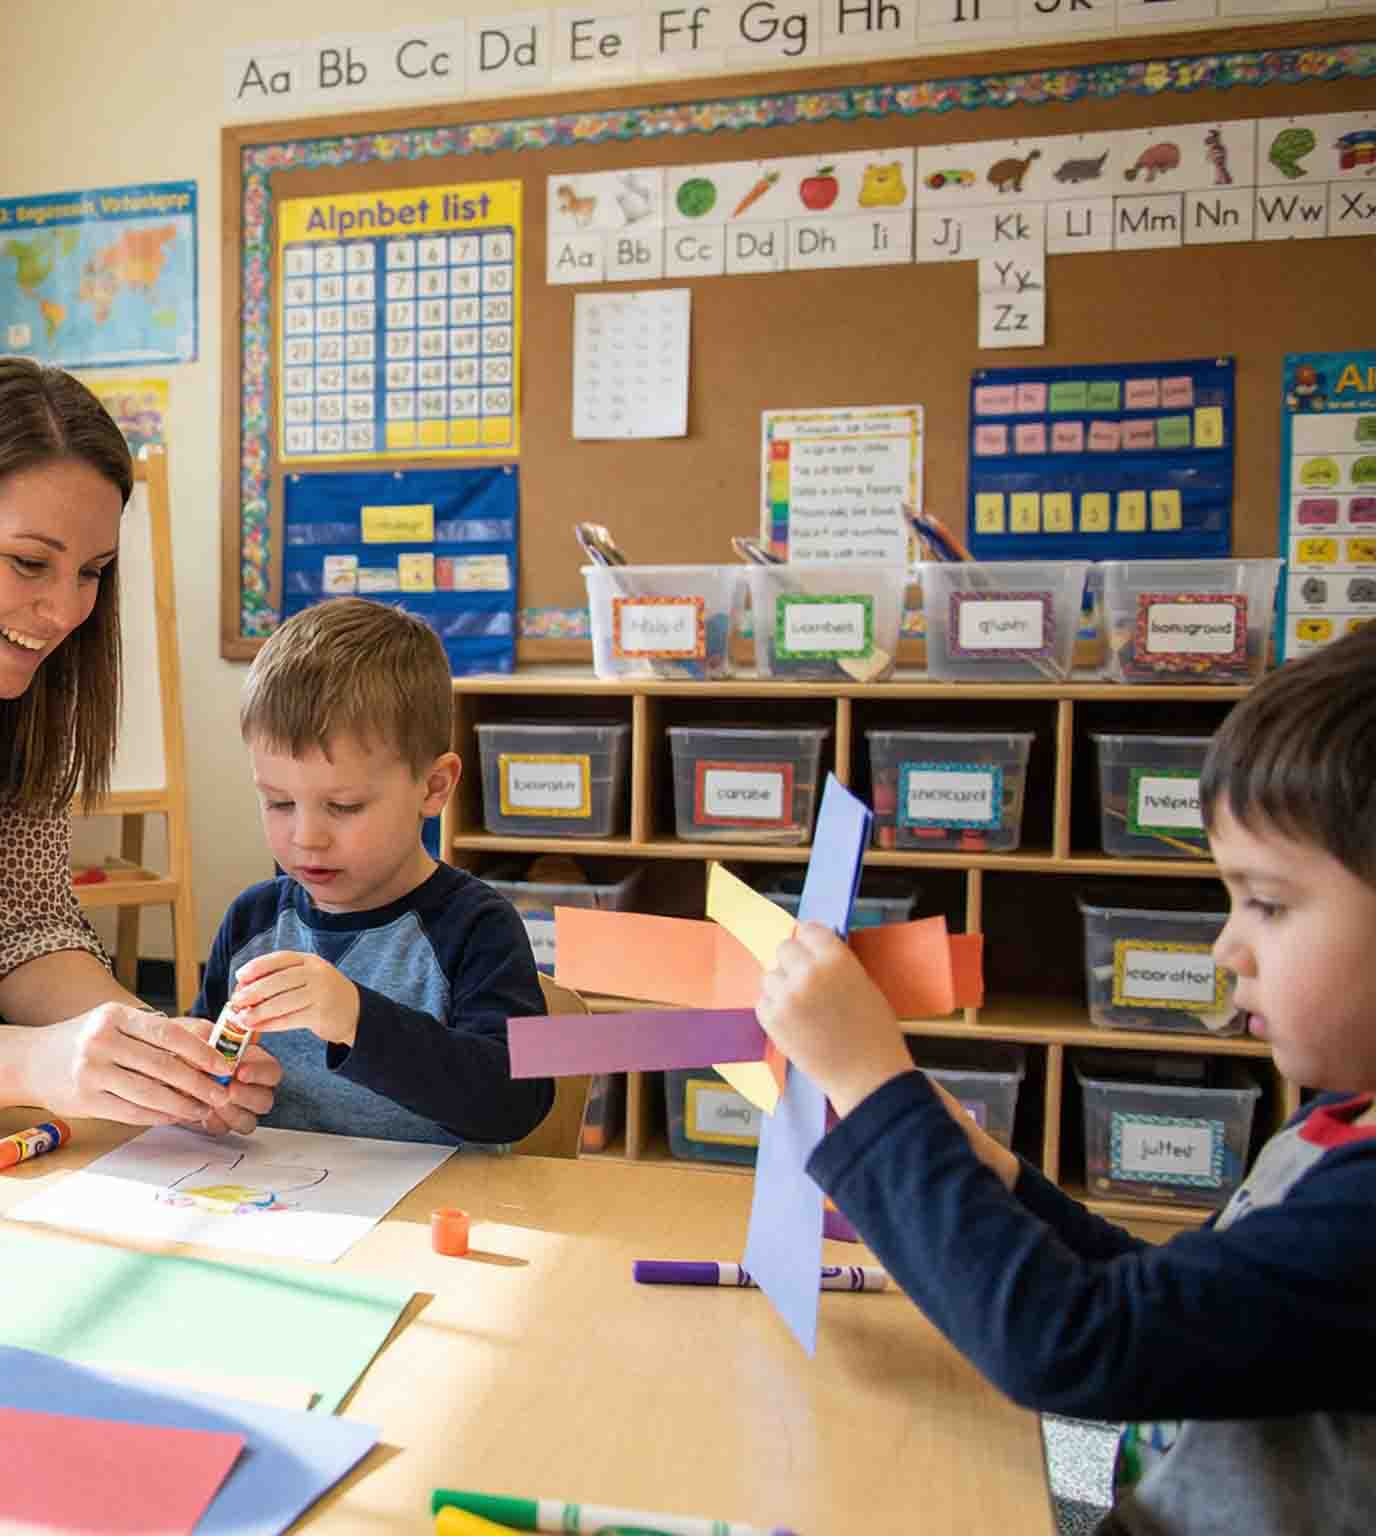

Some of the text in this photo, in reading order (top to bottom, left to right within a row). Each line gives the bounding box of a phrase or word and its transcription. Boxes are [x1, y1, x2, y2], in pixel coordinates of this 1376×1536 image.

[236, 58, 291, 99] Aa
[319, 47, 368, 89] Bb
[395, 39, 450, 79] Cc
[479, 25, 537, 72] Dd
[569, 19, 623, 61] Ee
[657, 6, 711, 53] Ff
[738, 1, 808, 57] Gg
[837, 0, 901, 35] Hh
[442, 191, 491, 222] list
[932, 217, 962, 255] Jj
[994, 212, 1031, 242] Kk
[1065, 208, 1092, 238] Ll
[1119, 206, 1177, 234] Mm
[1194, 200, 1240, 228] Nn
[1259, 195, 1323, 223] Ww
[556, 243, 593, 269] Aa
[616, 238, 651, 266] Bb
[674, 236, 713, 263] Cc
[735, 229, 774, 259] Dd
[994, 260, 1033, 293] Yy
[993, 303, 1029, 332] Zz
